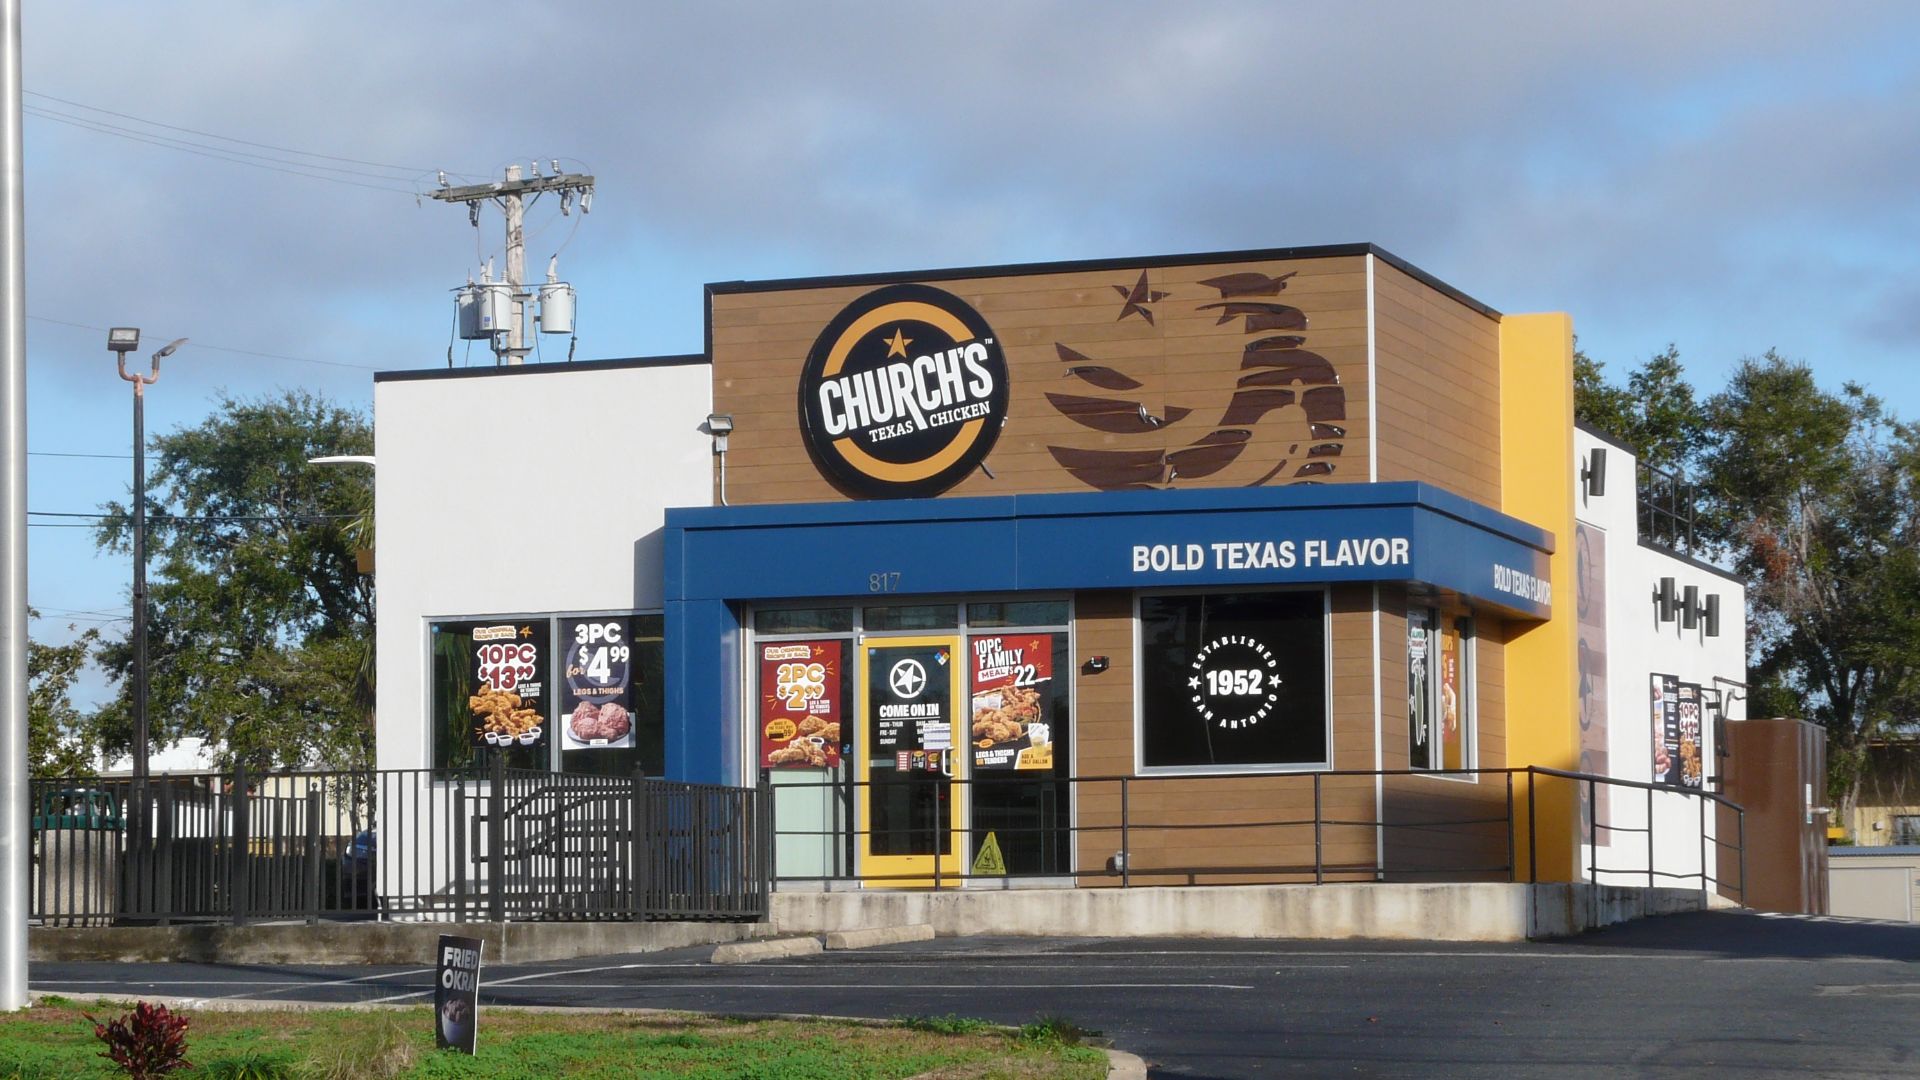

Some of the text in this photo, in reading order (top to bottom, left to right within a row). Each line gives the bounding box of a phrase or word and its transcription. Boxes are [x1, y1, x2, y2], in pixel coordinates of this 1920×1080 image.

[819, 342, 994, 435] CHURCH'S
[869, 401, 991, 443] TEXAS CHICKEN
[1132, 538, 1410, 572] BOLD TEXAS FLAVOR
[869, 572, 901, 592] 817
[1494, 563, 1552, 606] BOLD TEXAS FLAVOR
[574, 622, 621, 644] 3PC
[478, 644, 536, 664] 10PC
[973, 638, 1002, 655] 10PC
[1192, 635, 1277, 670] ESTABLISHED
[979, 648, 1023, 670] FAMILY
[566, 664, 585, 678] for
[778, 664, 824, 683] 2PC
[981, 670, 1006, 679] MEAL
[1206, 669, 1263, 695] 1952
[573, 688, 590, 696] LEGS
[598, 687, 624, 695] THIGHS
[879, 703, 940, 717] COME ON IN
[1192, 694, 1278, 729] SAN ANTONIO
[1679, 702, 1700, 719] 10PC
[443, 946, 478, 970] FRIED
[442, 968, 476, 992] OKRA
